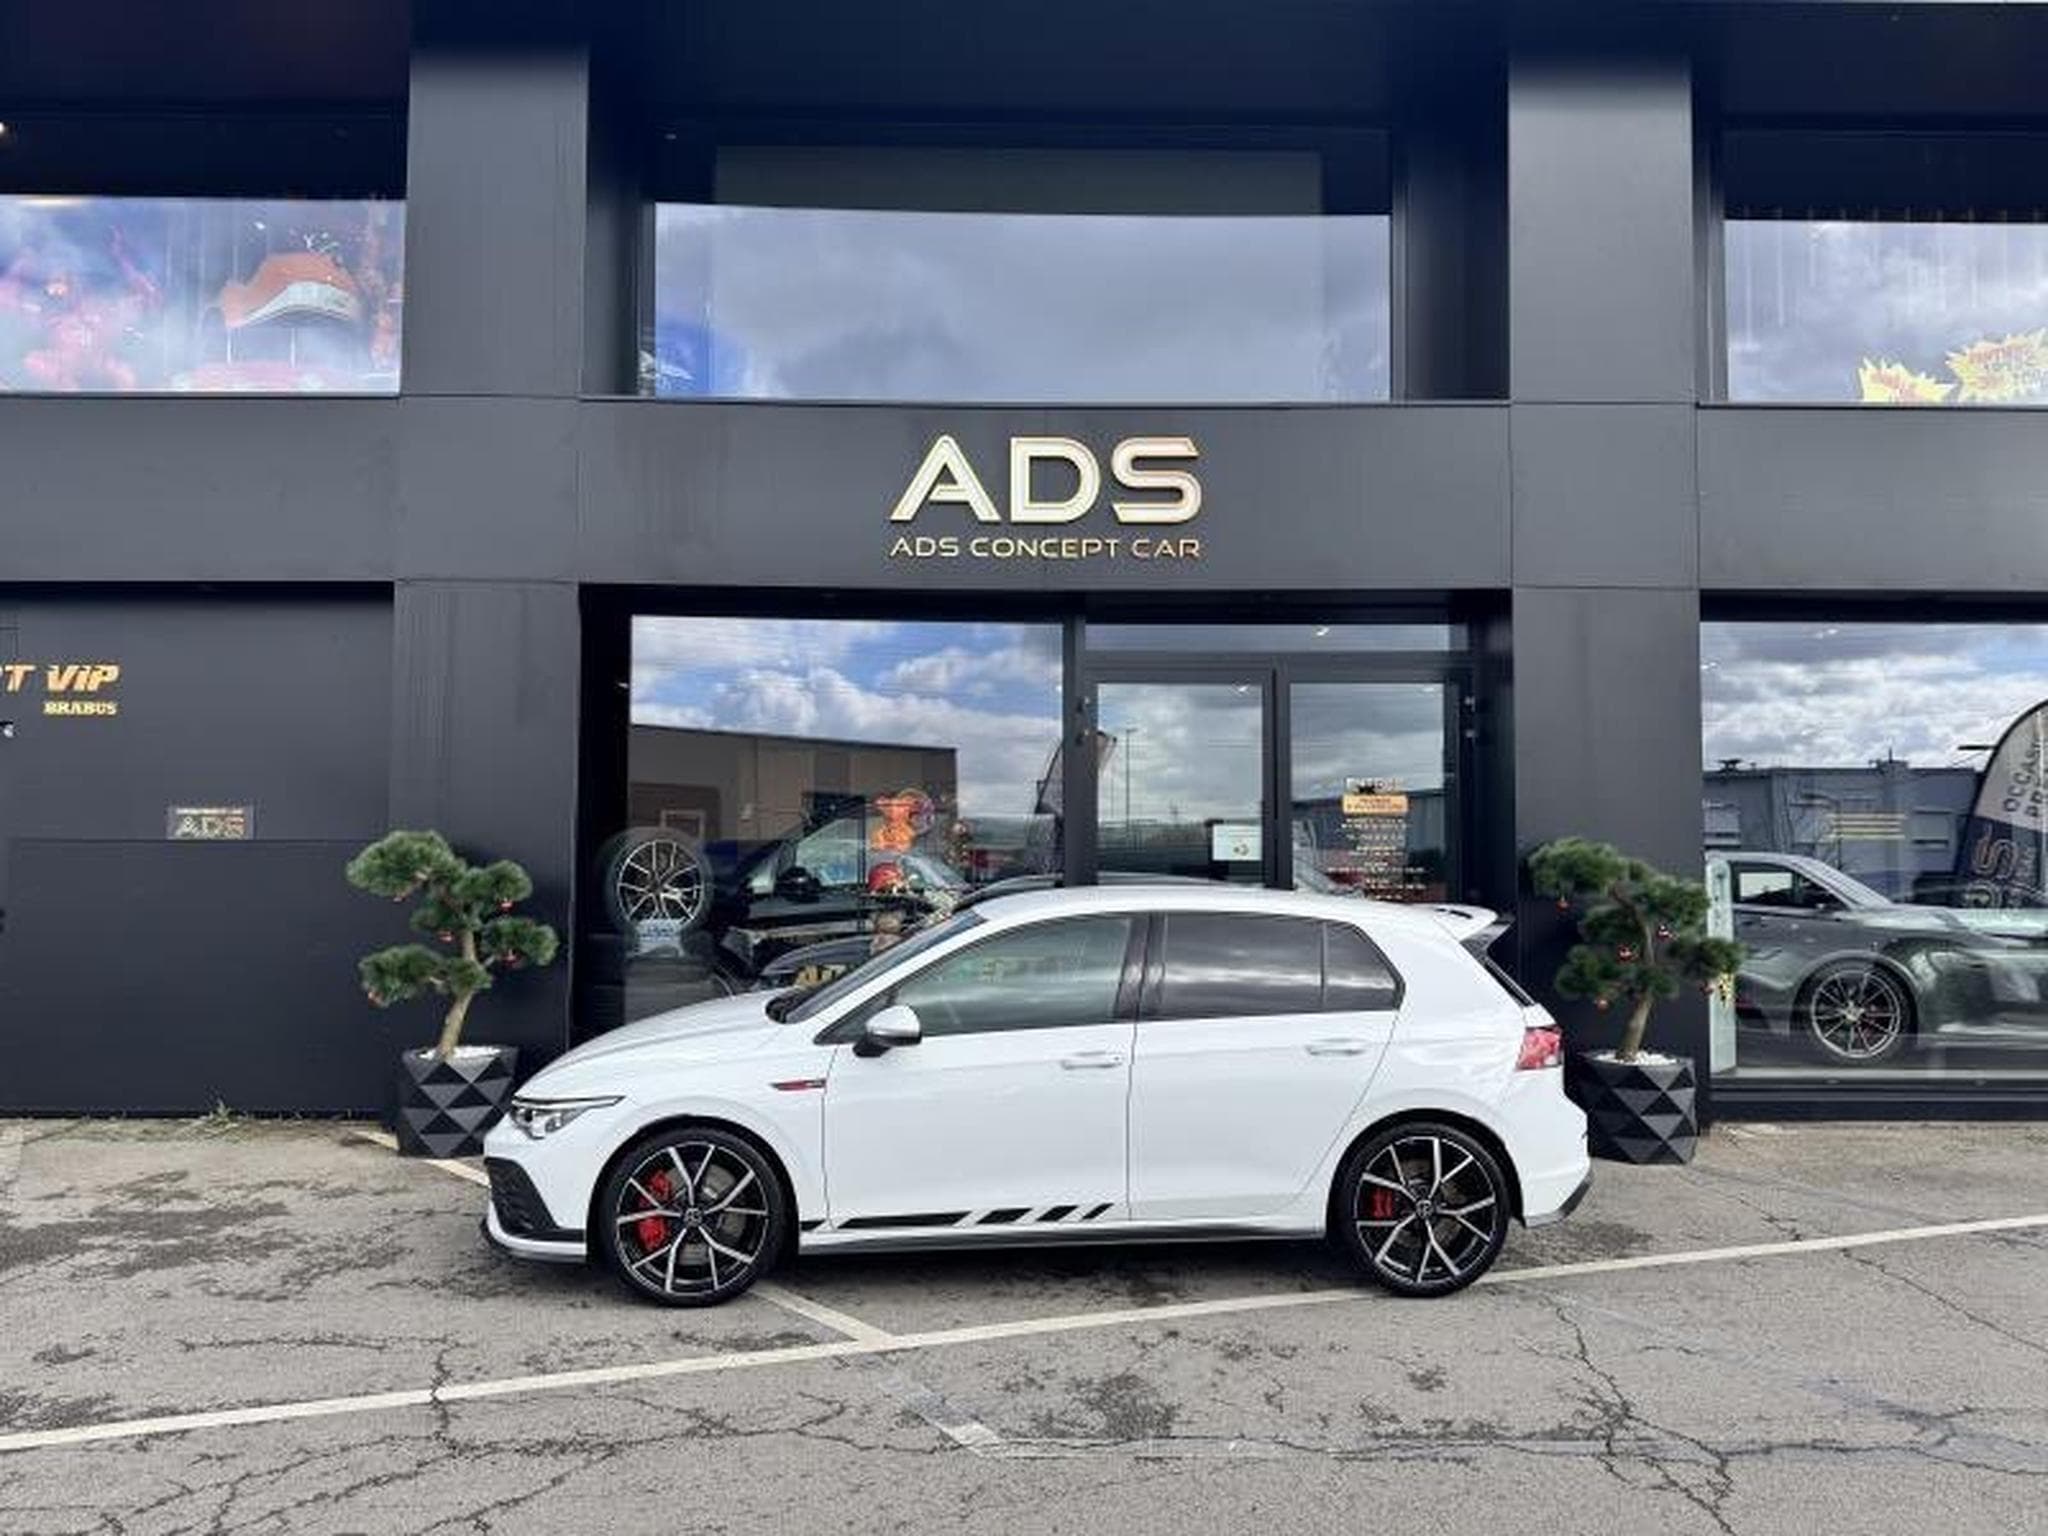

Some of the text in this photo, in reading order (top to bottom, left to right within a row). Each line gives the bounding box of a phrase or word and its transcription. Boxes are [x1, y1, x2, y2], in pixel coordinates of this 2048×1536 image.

[889, 434, 1202, 523] ADS
[890, 536, 1200, 559] ADS CONCEPT CAR
[43, 701, 117, 716] BRABUS
